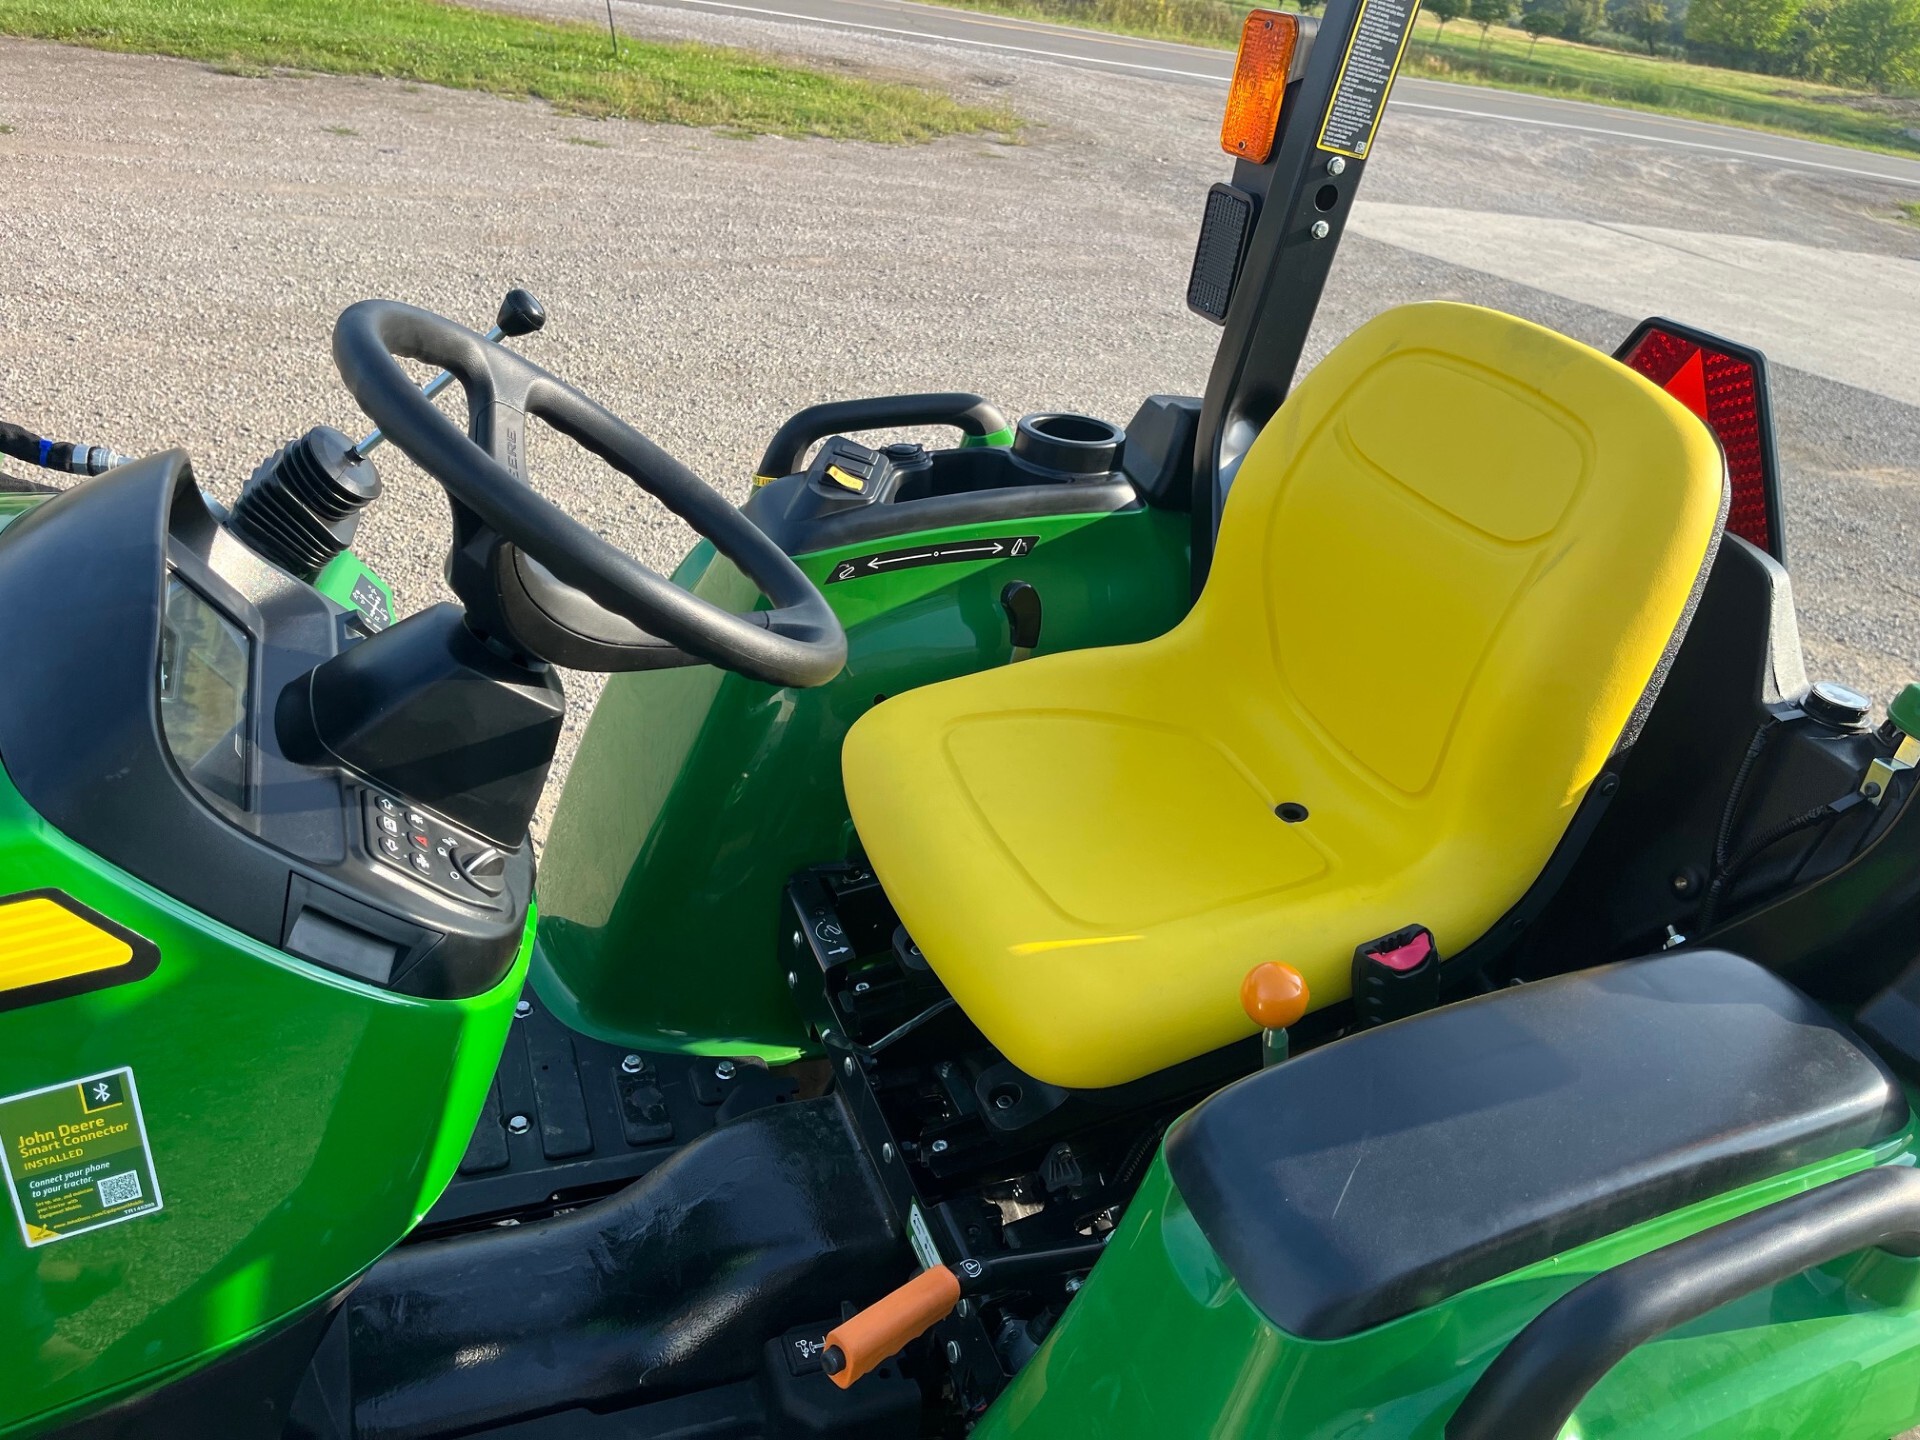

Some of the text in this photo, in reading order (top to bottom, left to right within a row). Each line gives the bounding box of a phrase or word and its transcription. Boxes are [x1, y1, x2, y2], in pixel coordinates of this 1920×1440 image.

[18, 1118, 105, 1149] John Deere
[19, 1122, 129, 1159] Smart Connector
[24, 1148, 84, 1171] INSTALLED
[29, 1161, 110, 1189] Connect your phone
[32, 1176, 94, 1198] to your tractor.
